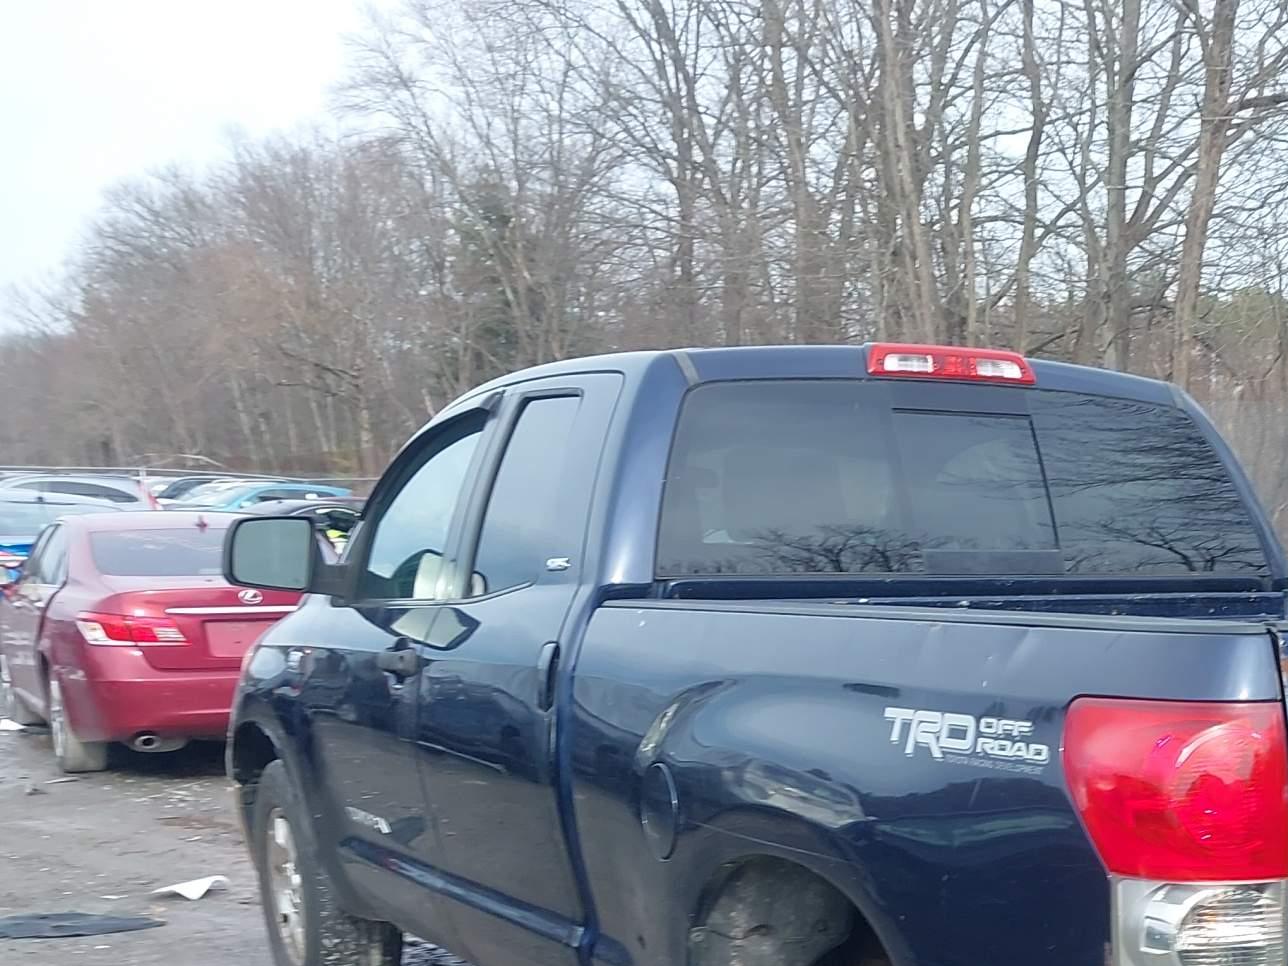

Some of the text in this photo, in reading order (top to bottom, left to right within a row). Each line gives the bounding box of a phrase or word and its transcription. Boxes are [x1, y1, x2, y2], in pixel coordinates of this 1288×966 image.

[884, 707, 1033, 762] TRD OFF
[976, 738, 1049, 764] ROAD
